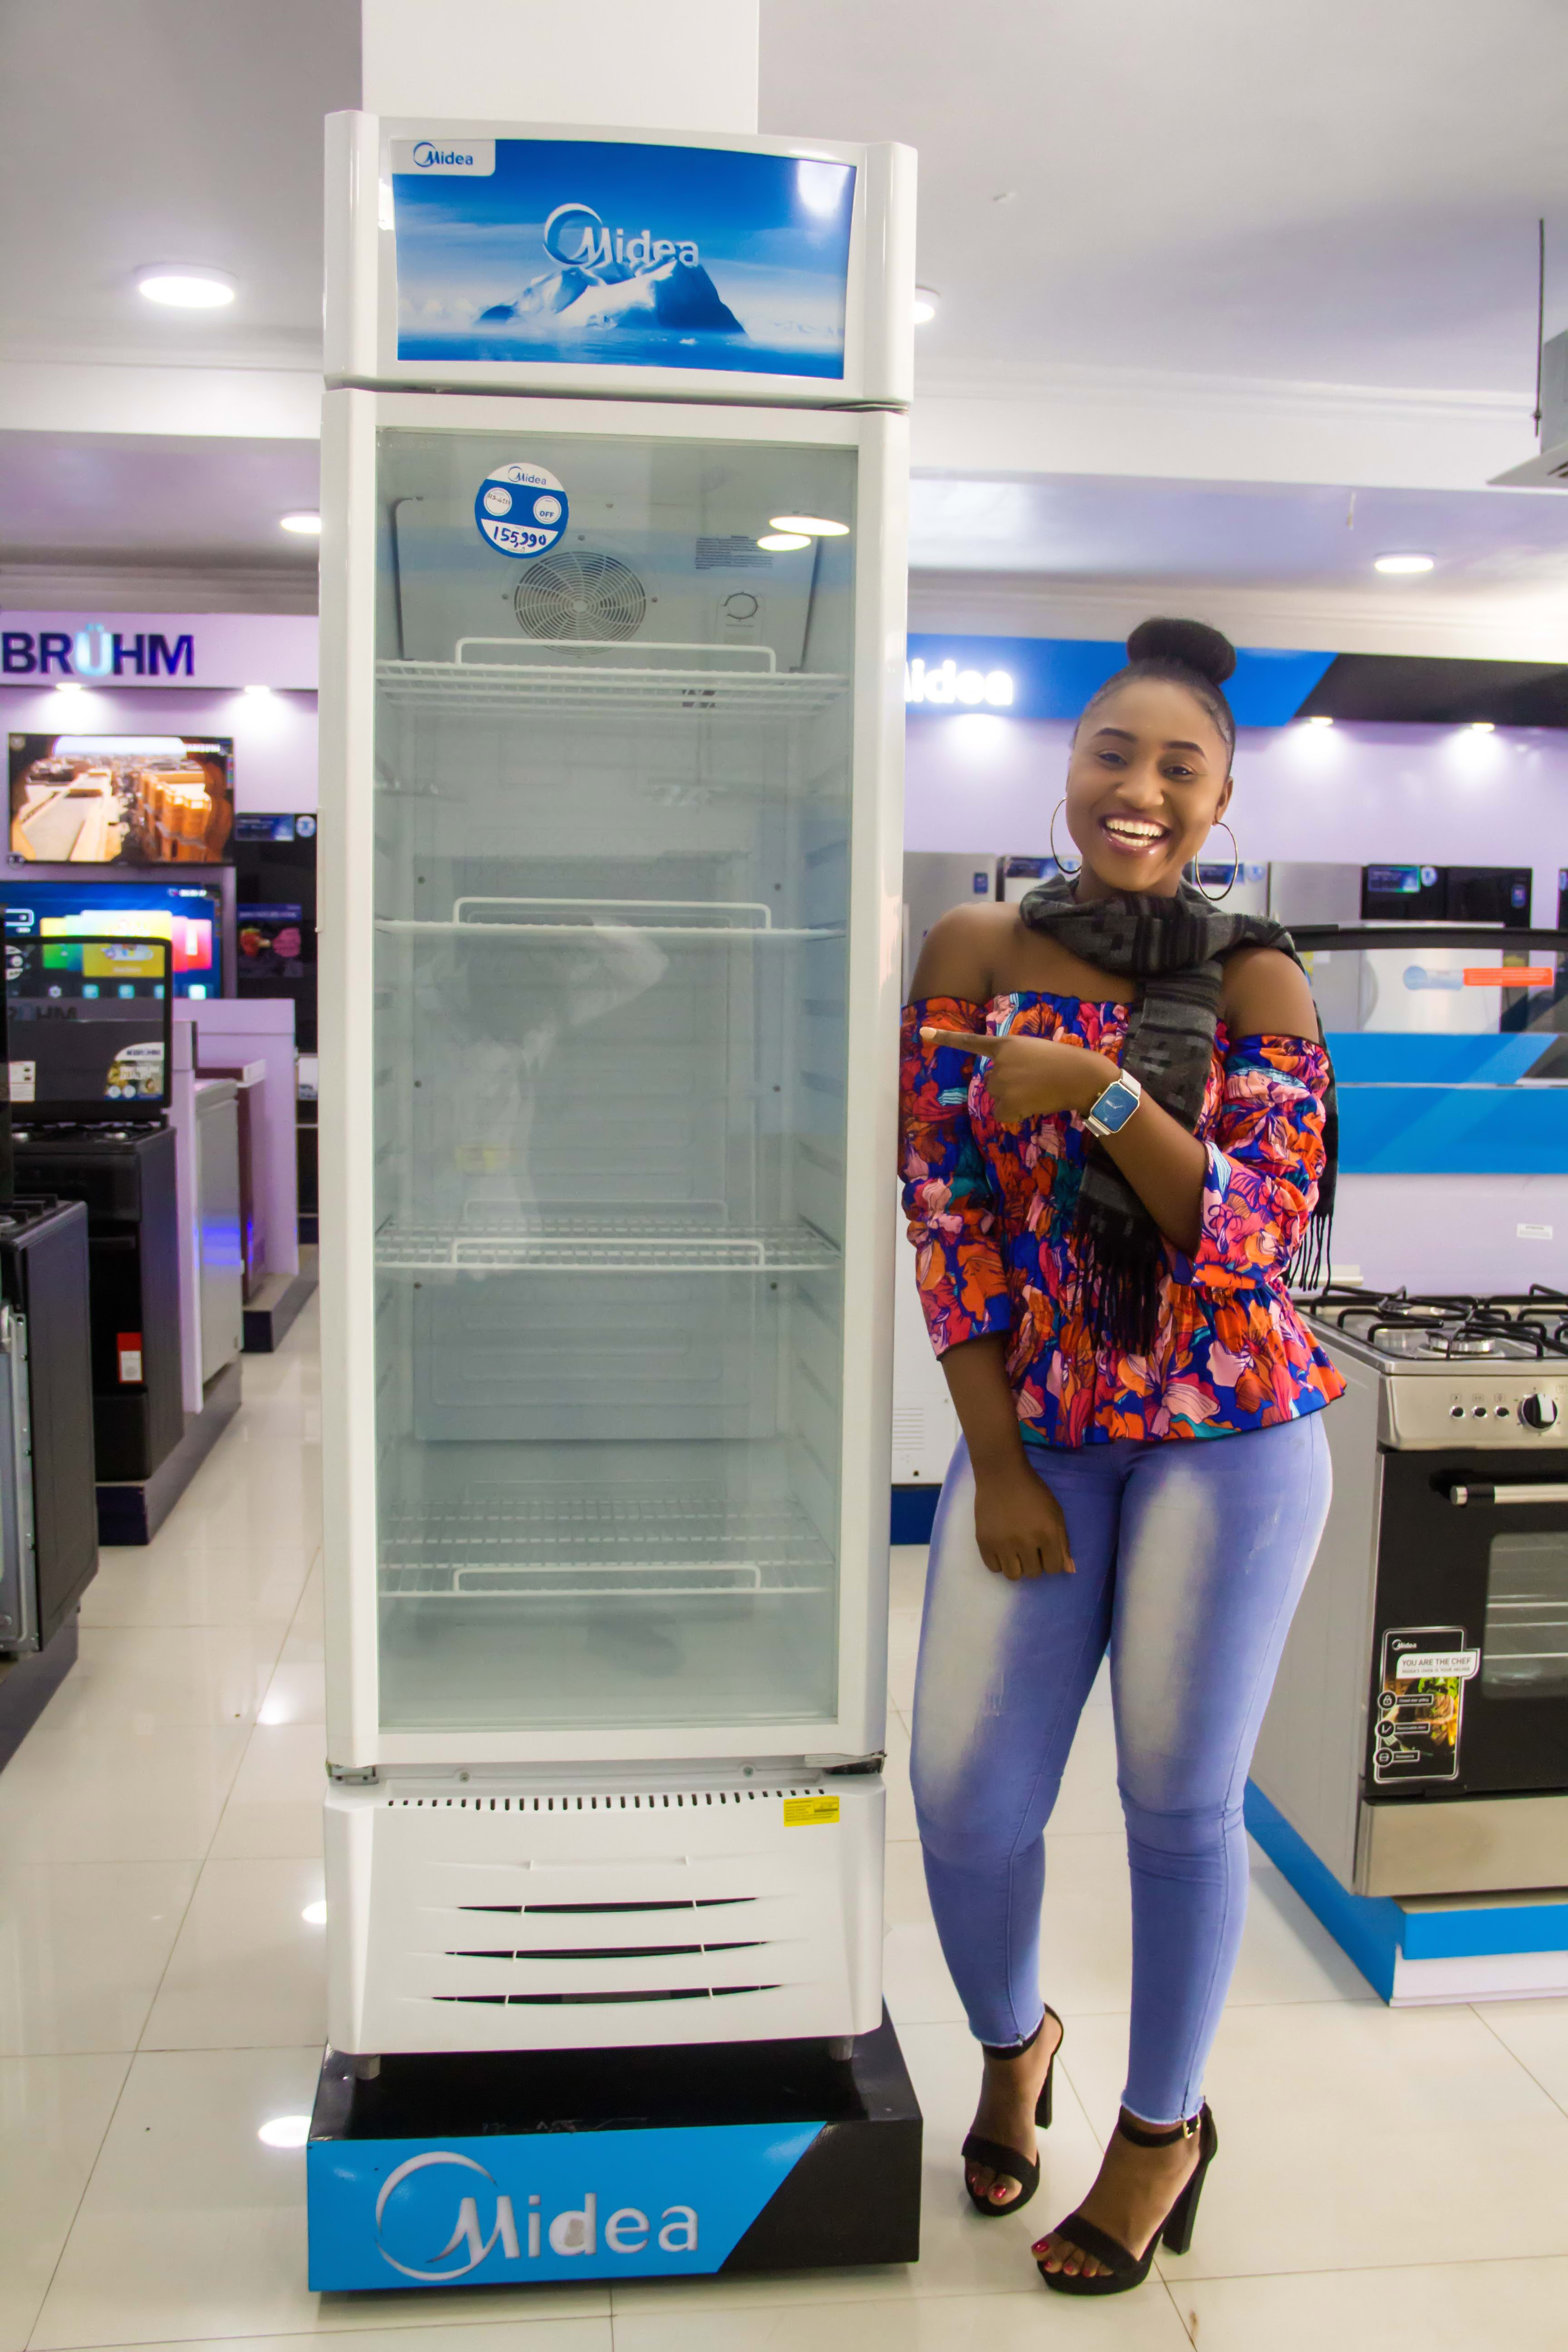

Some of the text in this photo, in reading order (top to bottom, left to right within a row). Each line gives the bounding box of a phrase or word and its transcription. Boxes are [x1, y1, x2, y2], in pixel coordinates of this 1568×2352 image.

[413, 142, 473, 167] Midea
[544, 203, 699, 268] Midea
[508, 466, 547, 485] Midea
[494, 526, 546, 548] 155,990
[375, 2151, 699, 2281] Midea
